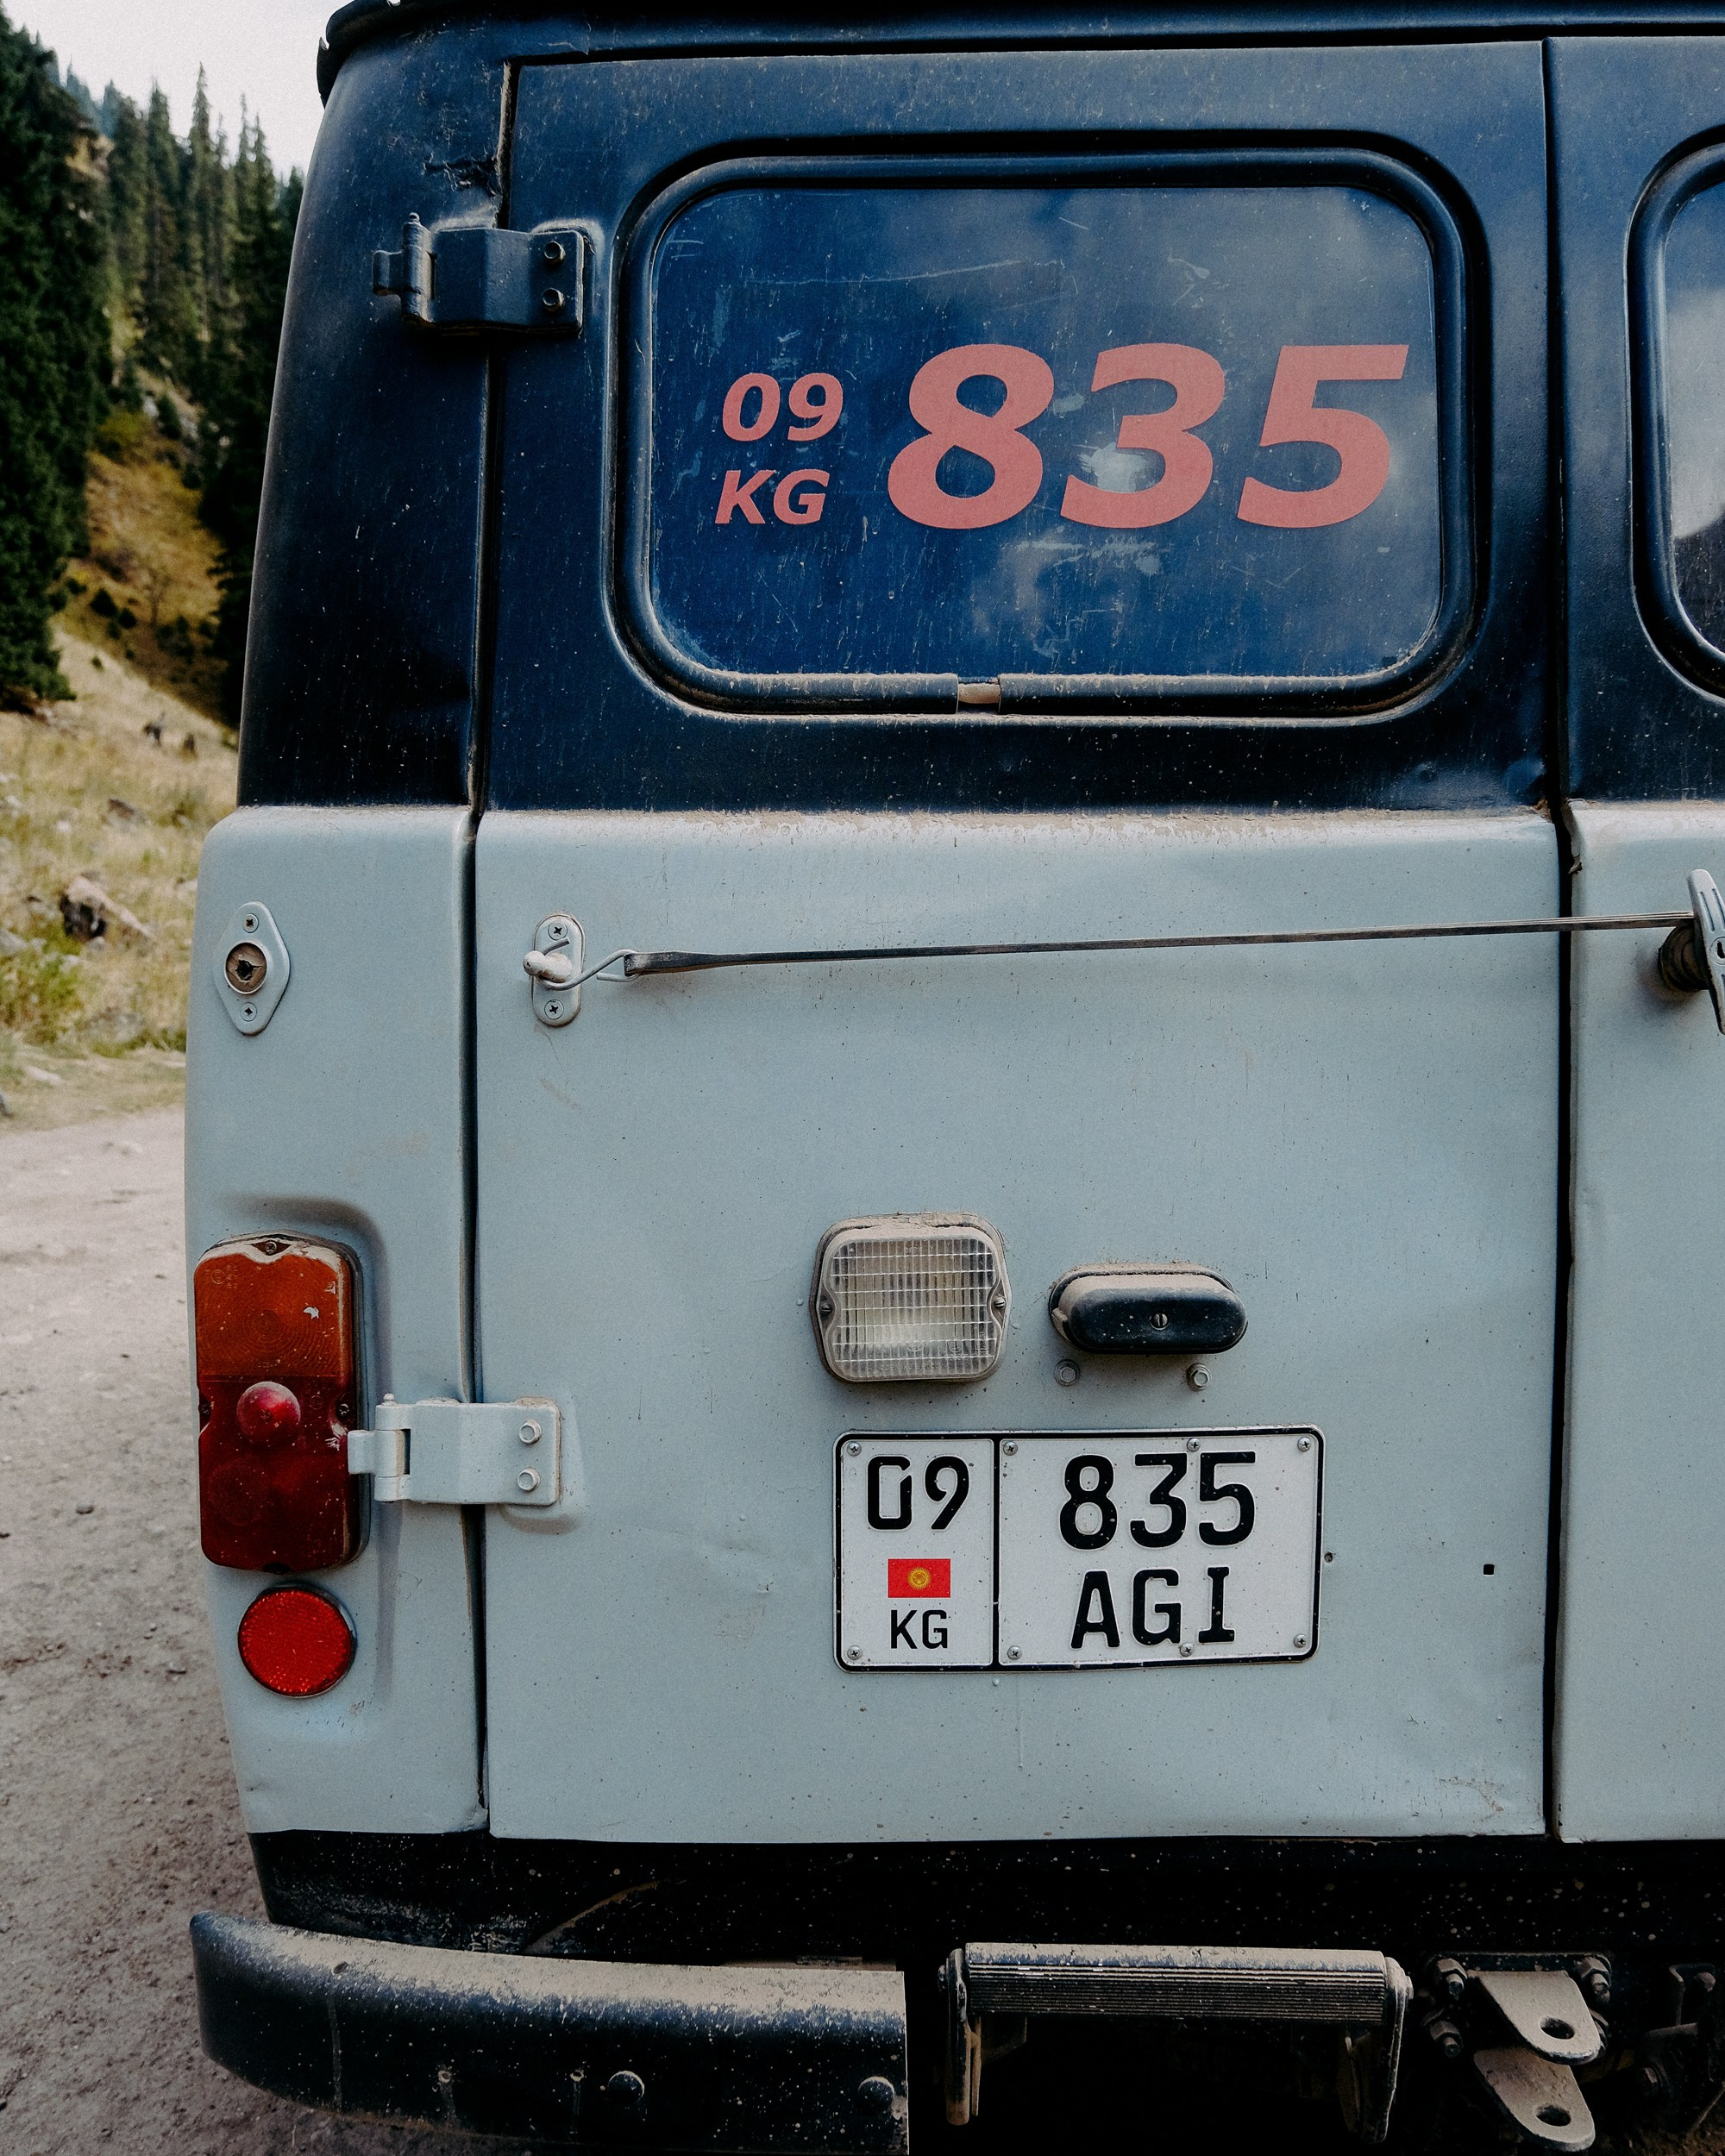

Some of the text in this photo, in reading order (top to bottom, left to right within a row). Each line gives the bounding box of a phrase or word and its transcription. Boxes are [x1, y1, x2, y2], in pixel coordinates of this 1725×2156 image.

[722, 373, 844, 442] 09
[888, 343, 1408, 530] 835
[715, 469, 830, 525] KG
[867, 1456, 969, 1531] 09
[1059, 1451, 1256, 1551] 835
[890, 1609, 948, 1650] KG
[1070, 1566, 1235, 1650] AGI
